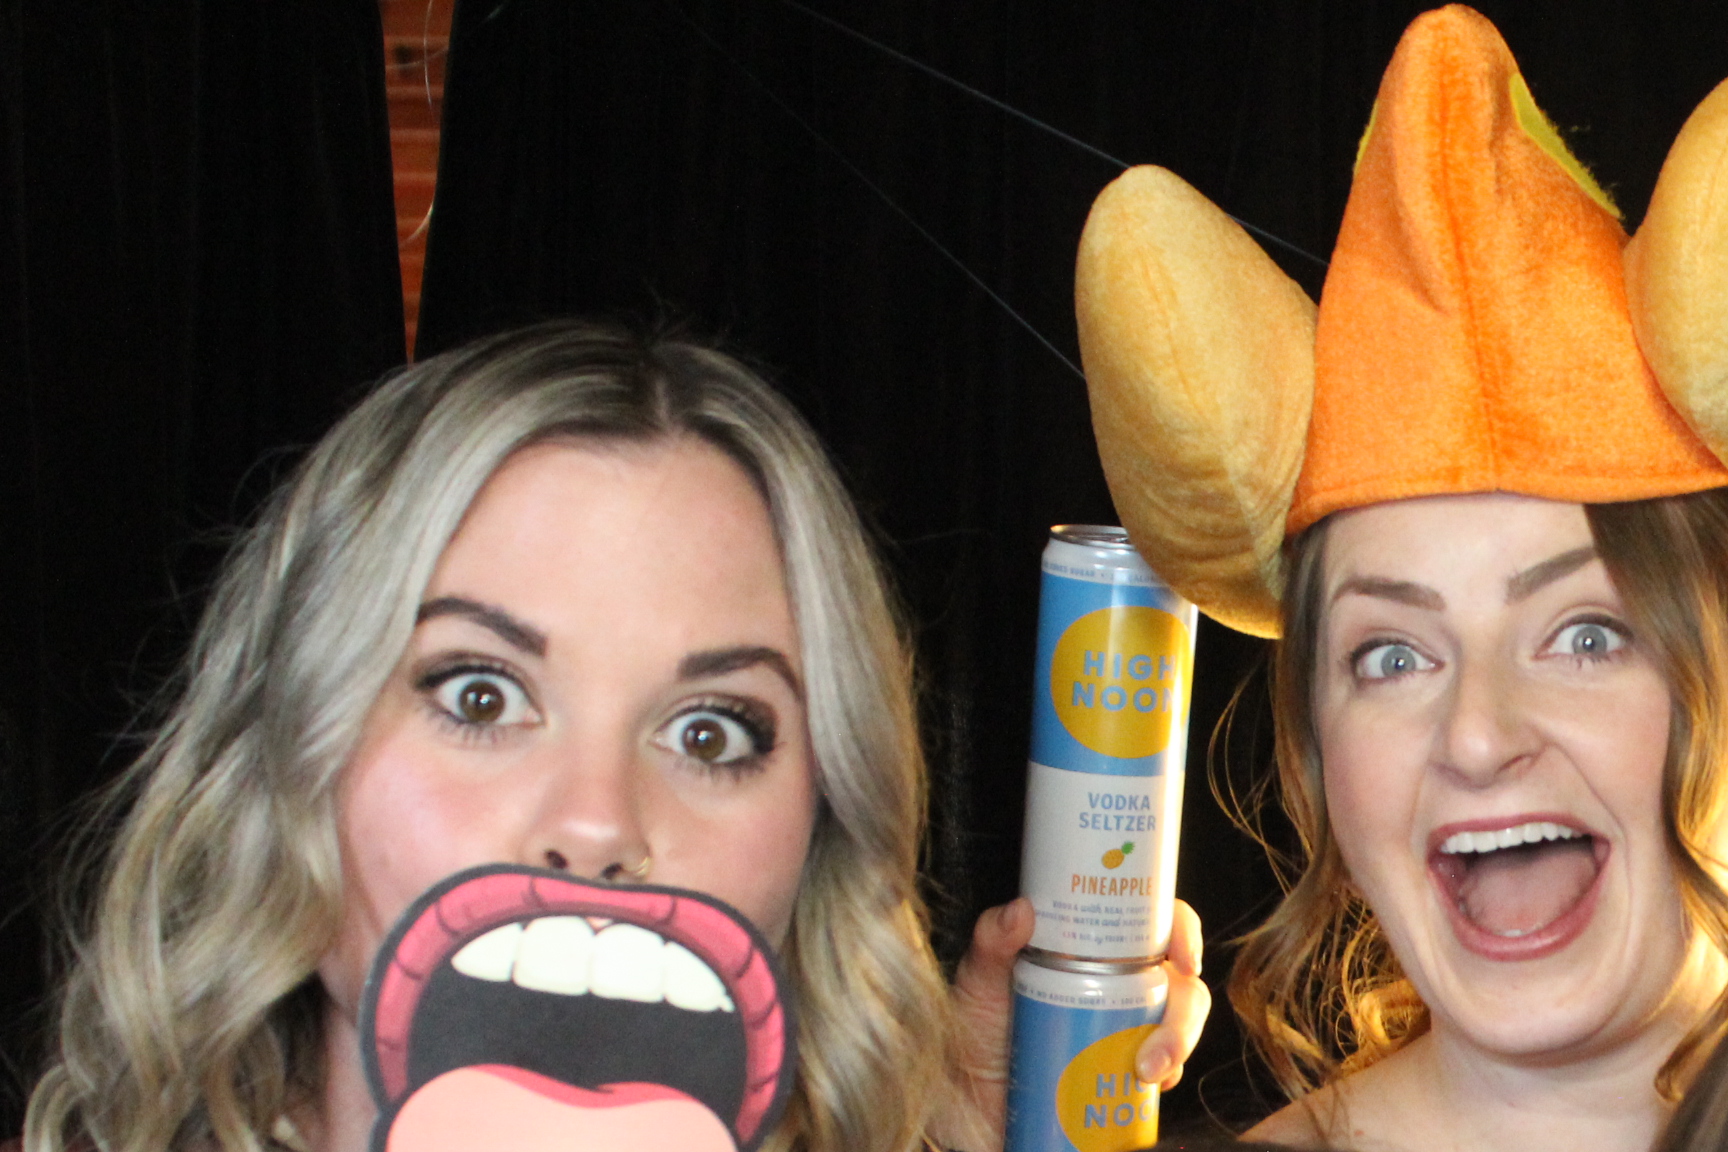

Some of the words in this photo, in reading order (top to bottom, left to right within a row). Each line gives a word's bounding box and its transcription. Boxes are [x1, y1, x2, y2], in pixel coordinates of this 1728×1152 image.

[1083, 650, 1176, 681] HIGH
[1087, 791, 1150, 811] VODKA
[1079, 812, 1156, 832] SELTZER
[1071, 873, 1153, 896] PINEAPPLE
